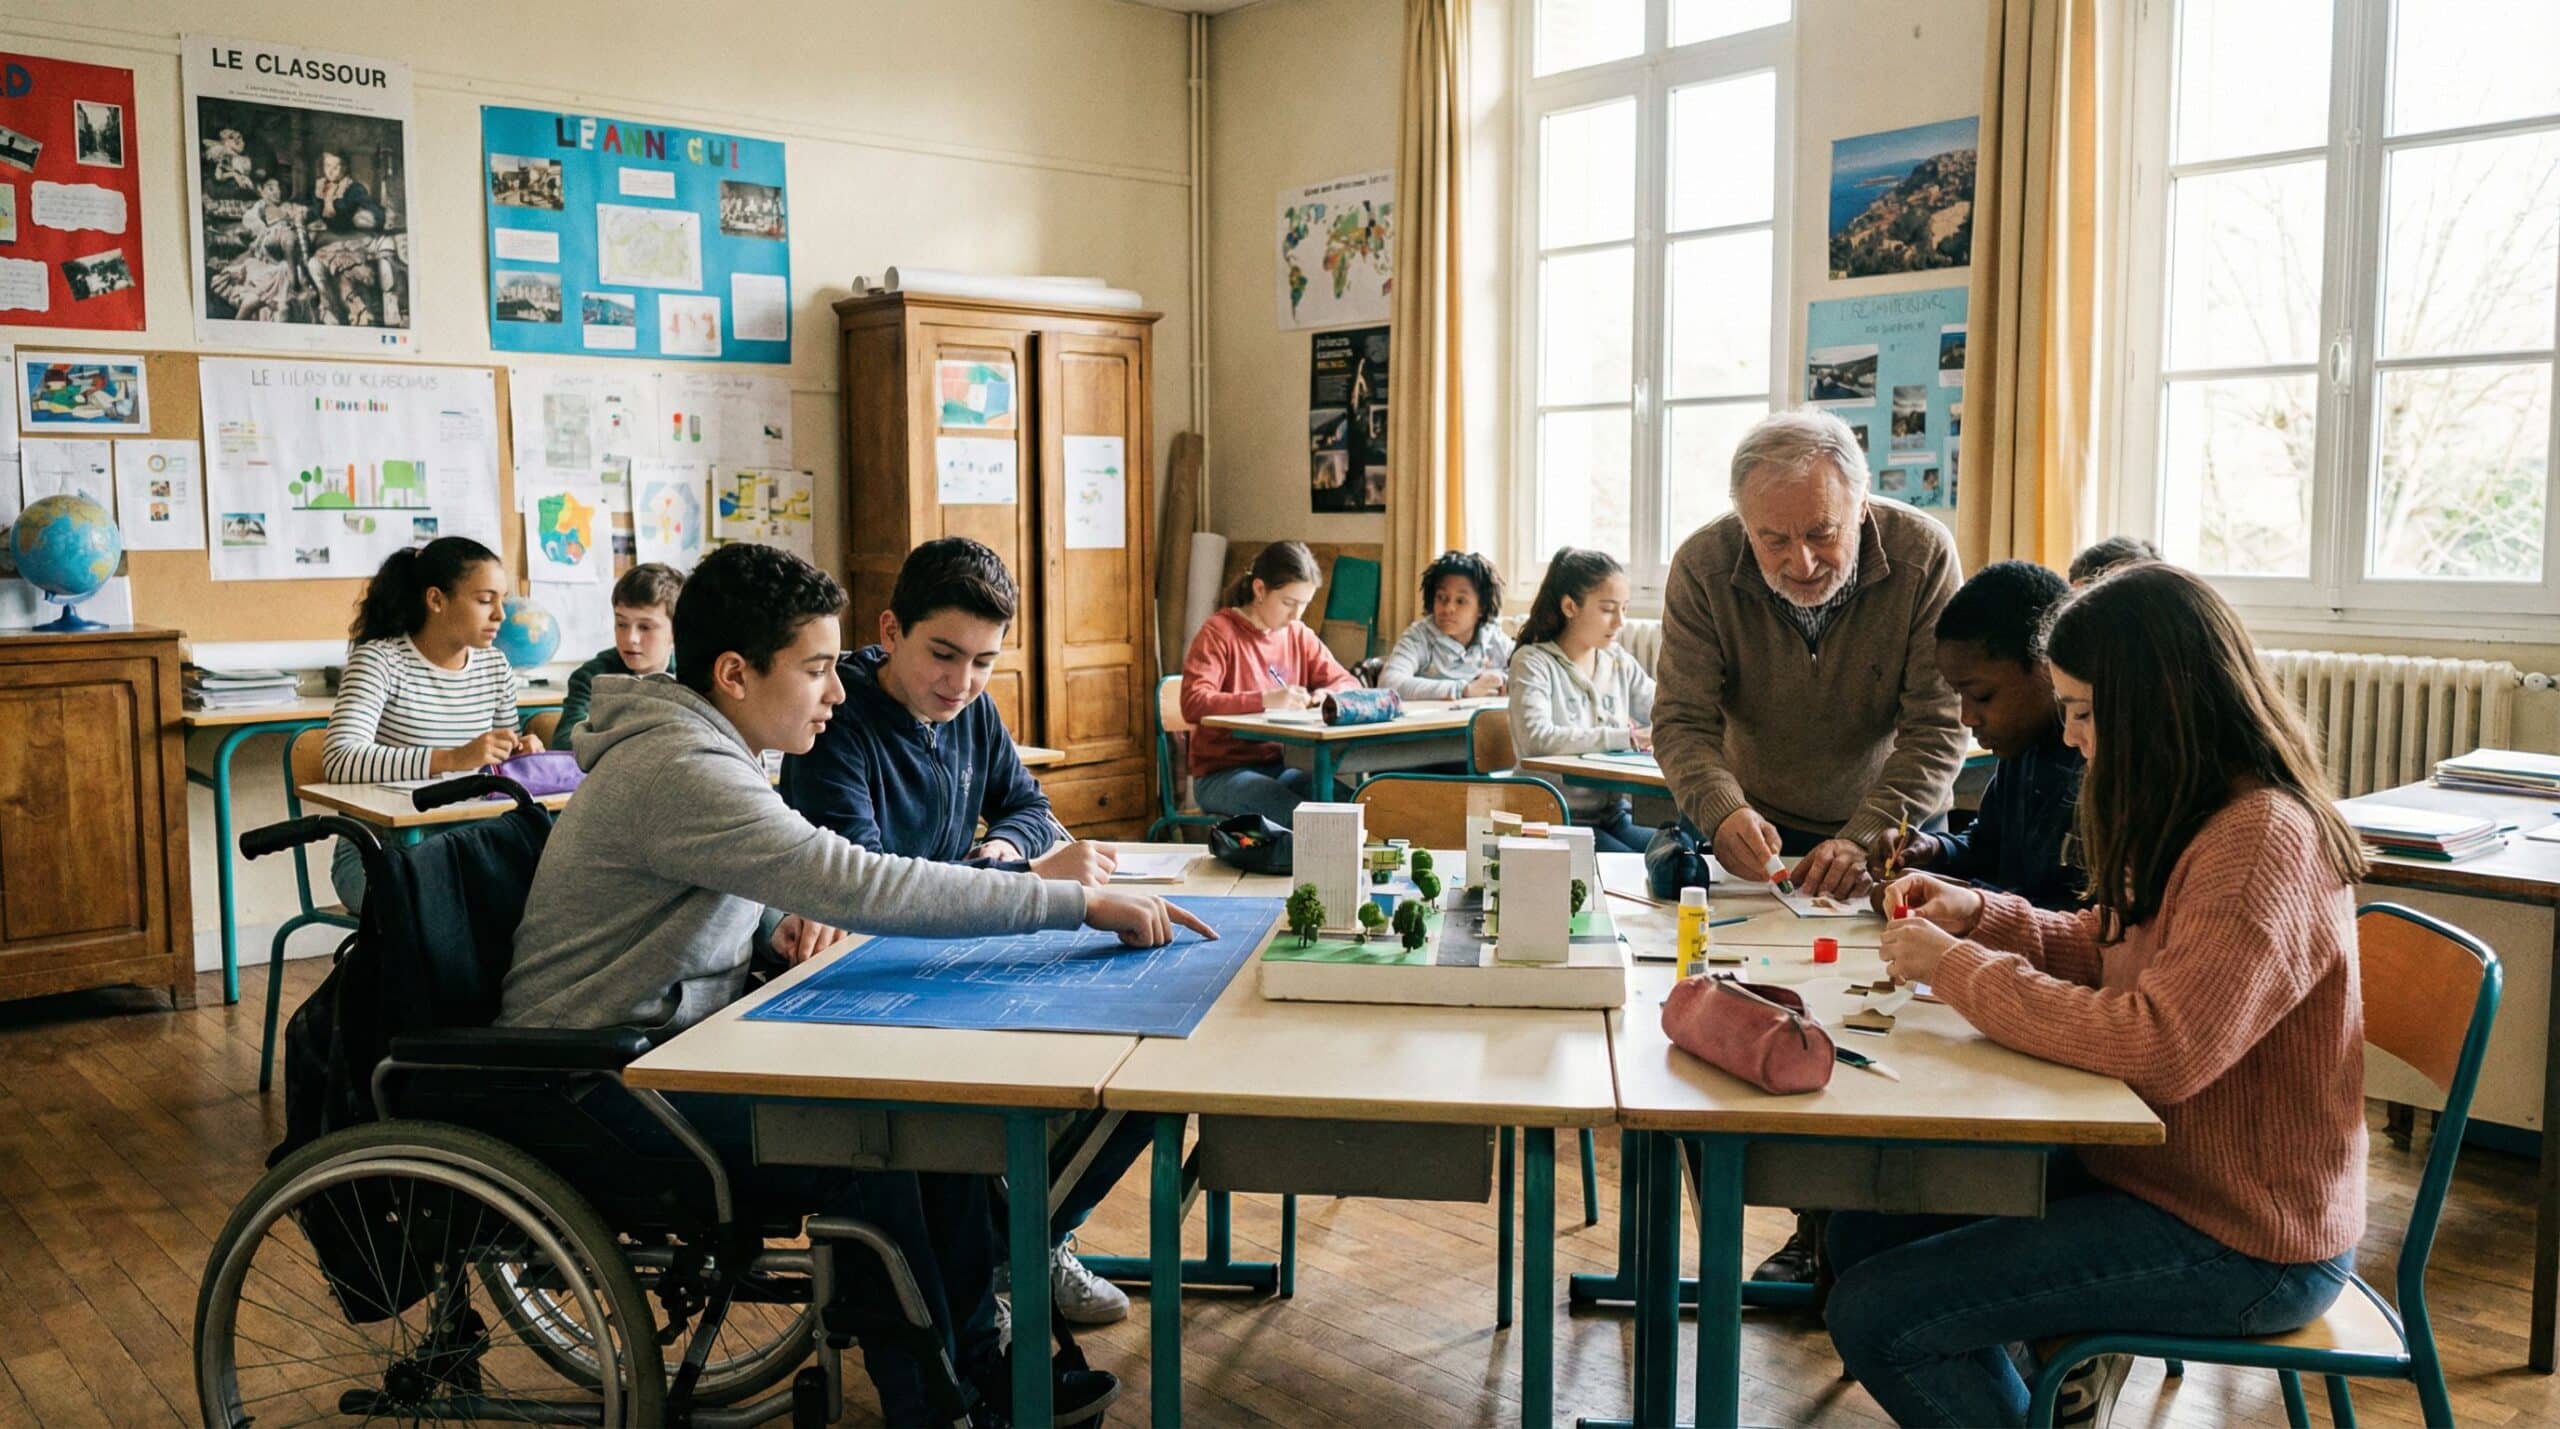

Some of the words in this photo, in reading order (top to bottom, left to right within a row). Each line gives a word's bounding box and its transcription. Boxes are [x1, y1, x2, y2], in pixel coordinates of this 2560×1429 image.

[0, 64, 32, 97] D
[212, 47, 243, 71] LE
[255, 53, 387, 89] CLASSOUR
[251, 368, 272, 387] LE
